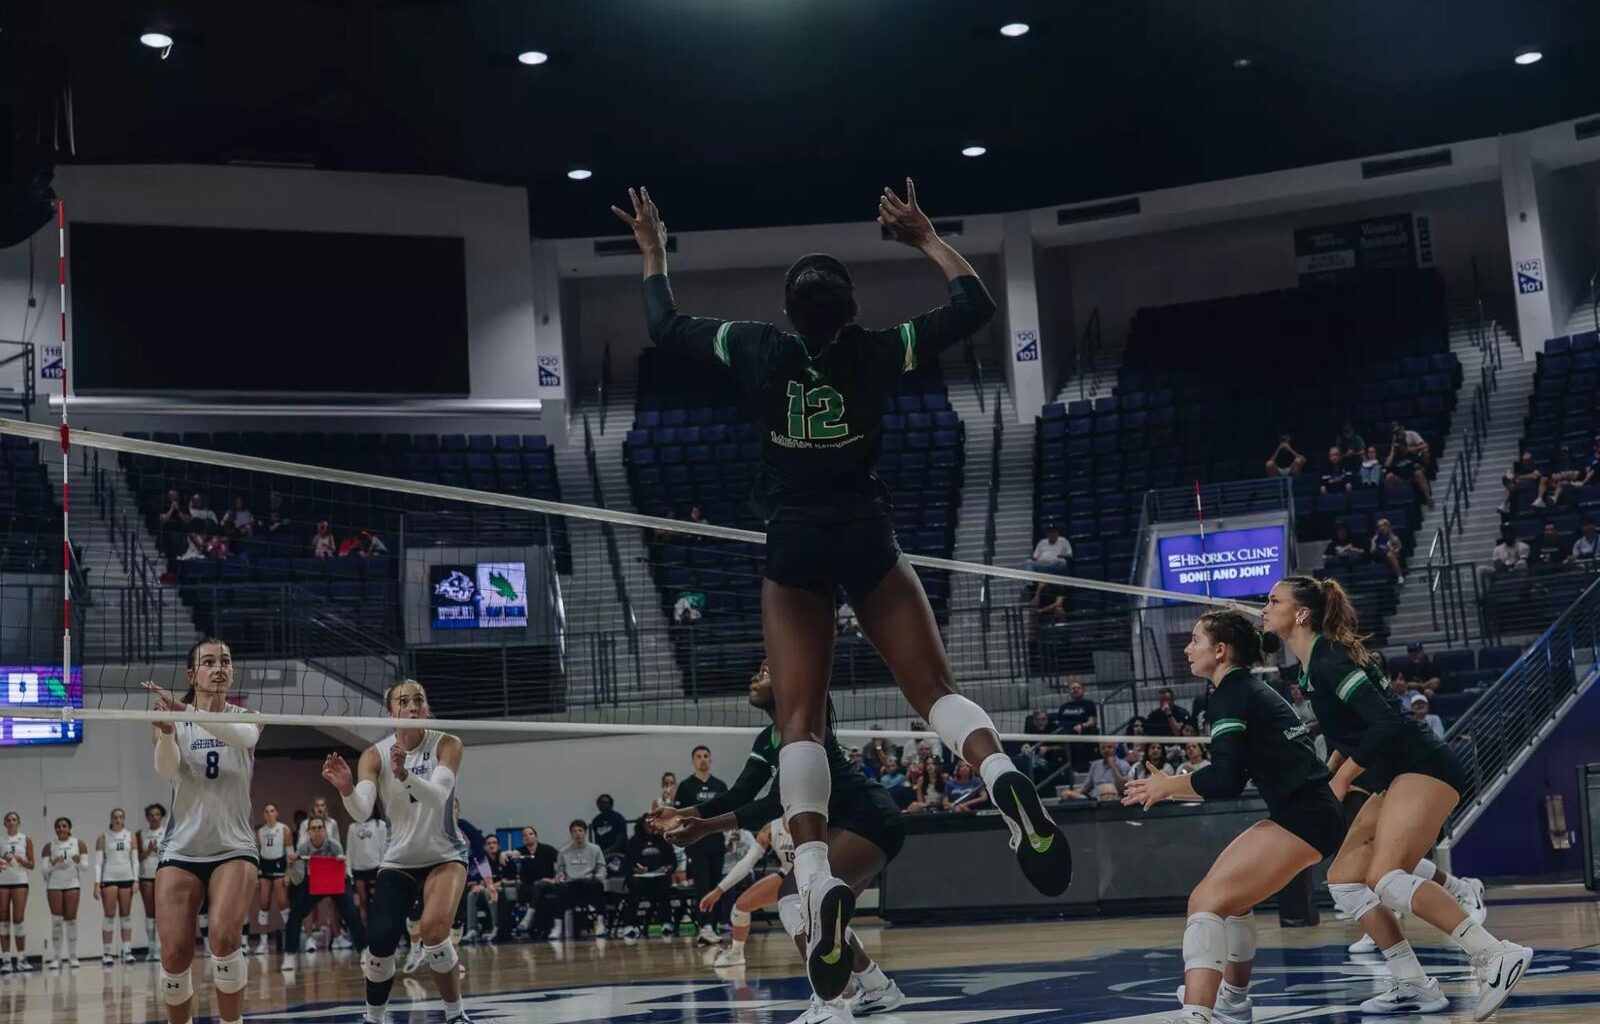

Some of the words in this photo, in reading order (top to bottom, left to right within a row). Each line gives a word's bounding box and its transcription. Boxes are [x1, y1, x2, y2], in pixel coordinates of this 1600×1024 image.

[1520, 261, 1538, 271] 102
[1522, 281, 1541, 292] 101
[1018, 332, 1034, 341] 120
[1019, 350, 1036, 360] 101
[787, 380, 848, 439] 12
[1180, 551, 1235, 567] HENDRICK
[1237, 546, 1279, 560] CLINIC
[1213, 567, 1238, 580] AND
[1239, 564, 1271, 578] JOINT
[206, 751, 219, 779] 8
